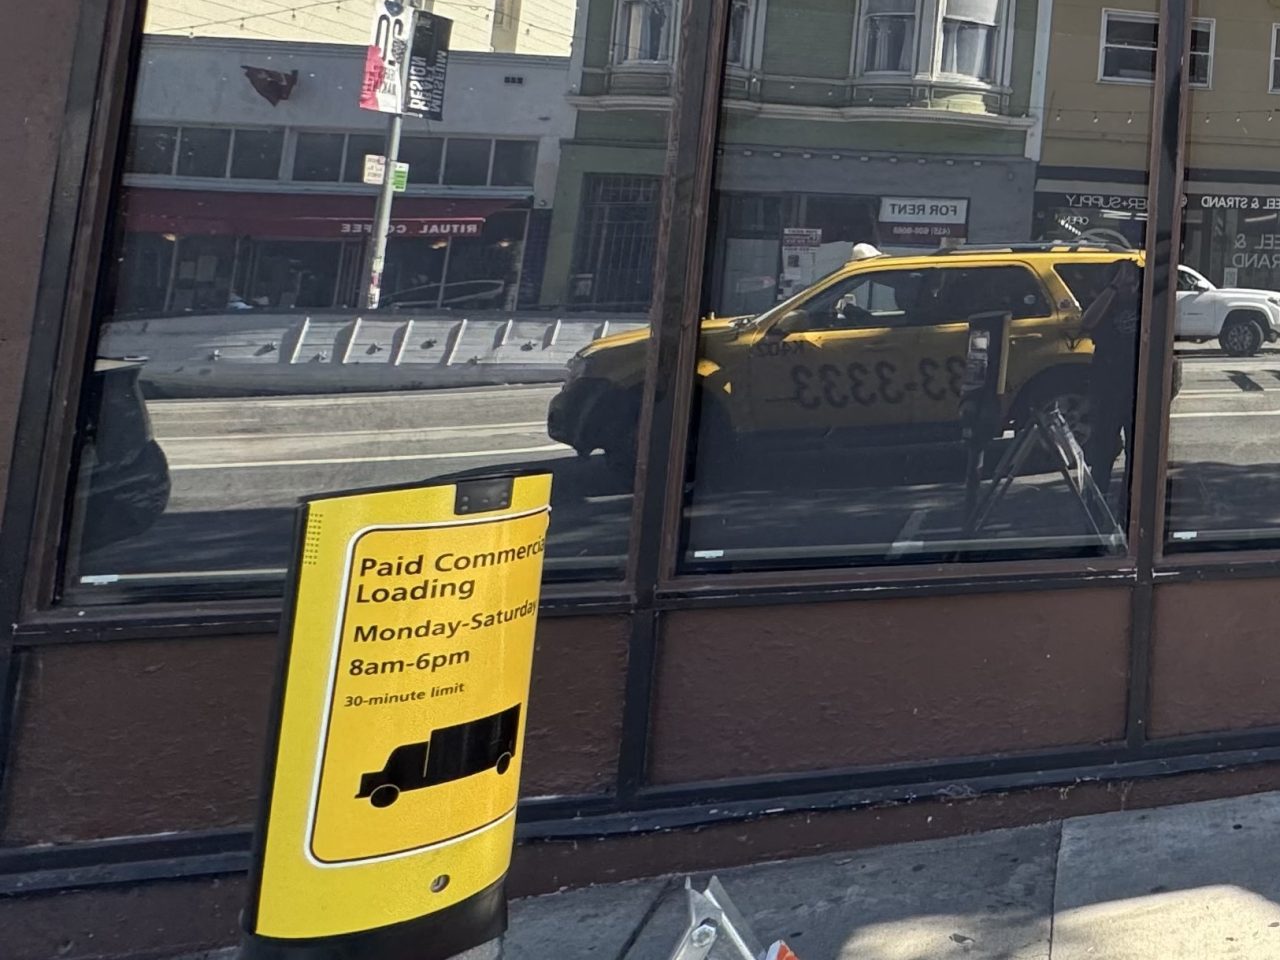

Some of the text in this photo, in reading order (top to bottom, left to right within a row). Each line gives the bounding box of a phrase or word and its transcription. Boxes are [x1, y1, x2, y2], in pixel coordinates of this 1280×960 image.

[359, 536, 545, 577] Paid Commercia
[356, 578, 476, 604] Loading
[353, 599, 537, 643] Monday-Saturday
[349, 649, 471, 677] 8am-6pm
[344, 682, 465, 708] 30-minute limit
